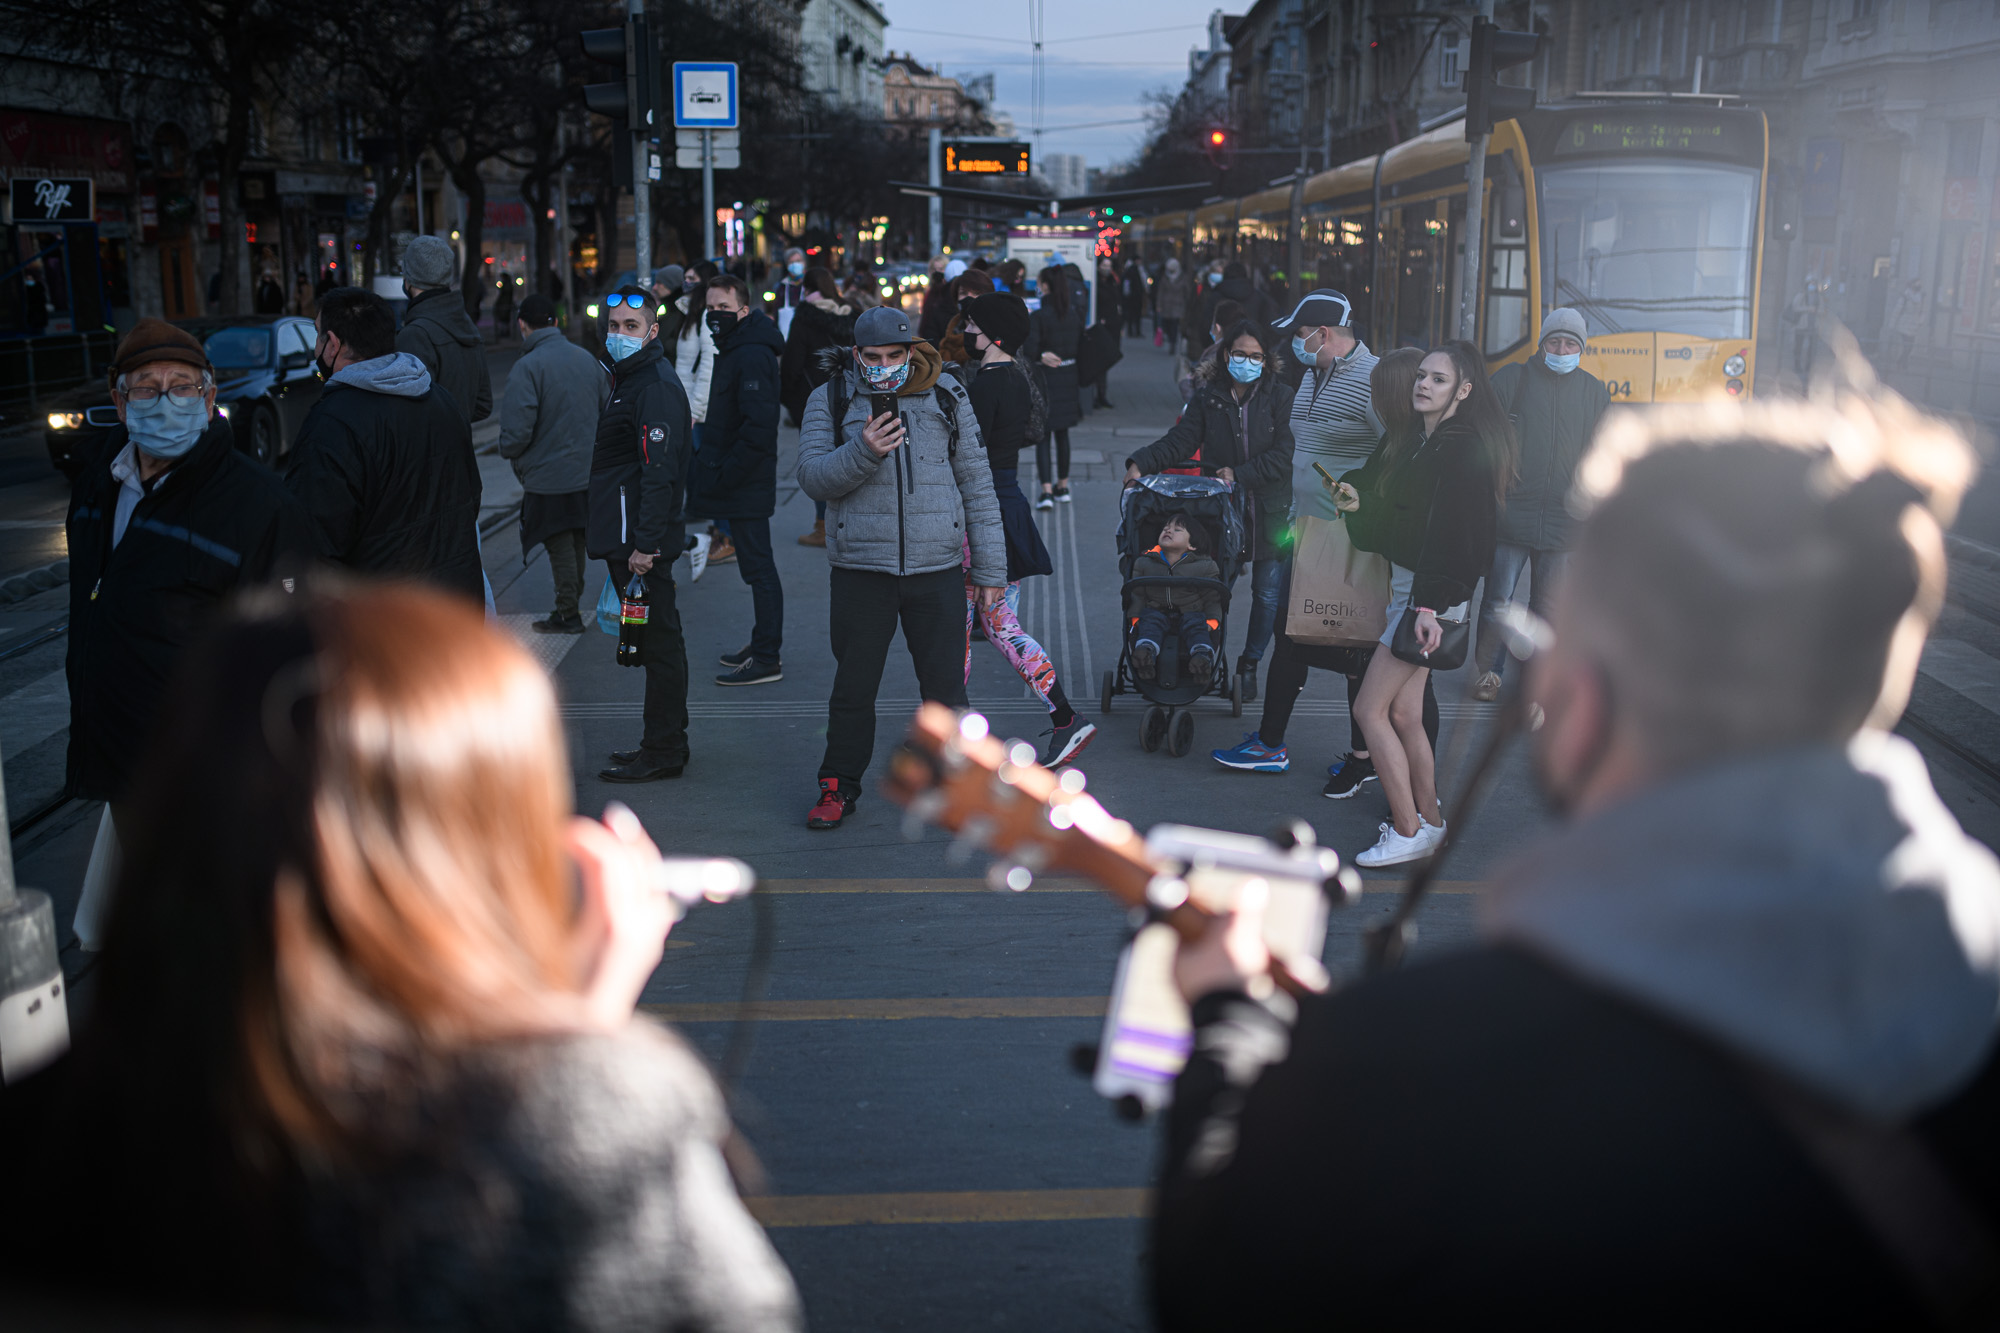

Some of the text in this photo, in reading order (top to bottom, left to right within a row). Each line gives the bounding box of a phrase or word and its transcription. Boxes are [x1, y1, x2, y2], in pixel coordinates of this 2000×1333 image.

[1573, 121, 1585, 147] 6
[1601, 347, 1649, 355] BUDAPEST
[1303, 599, 1368, 618] Bershka
